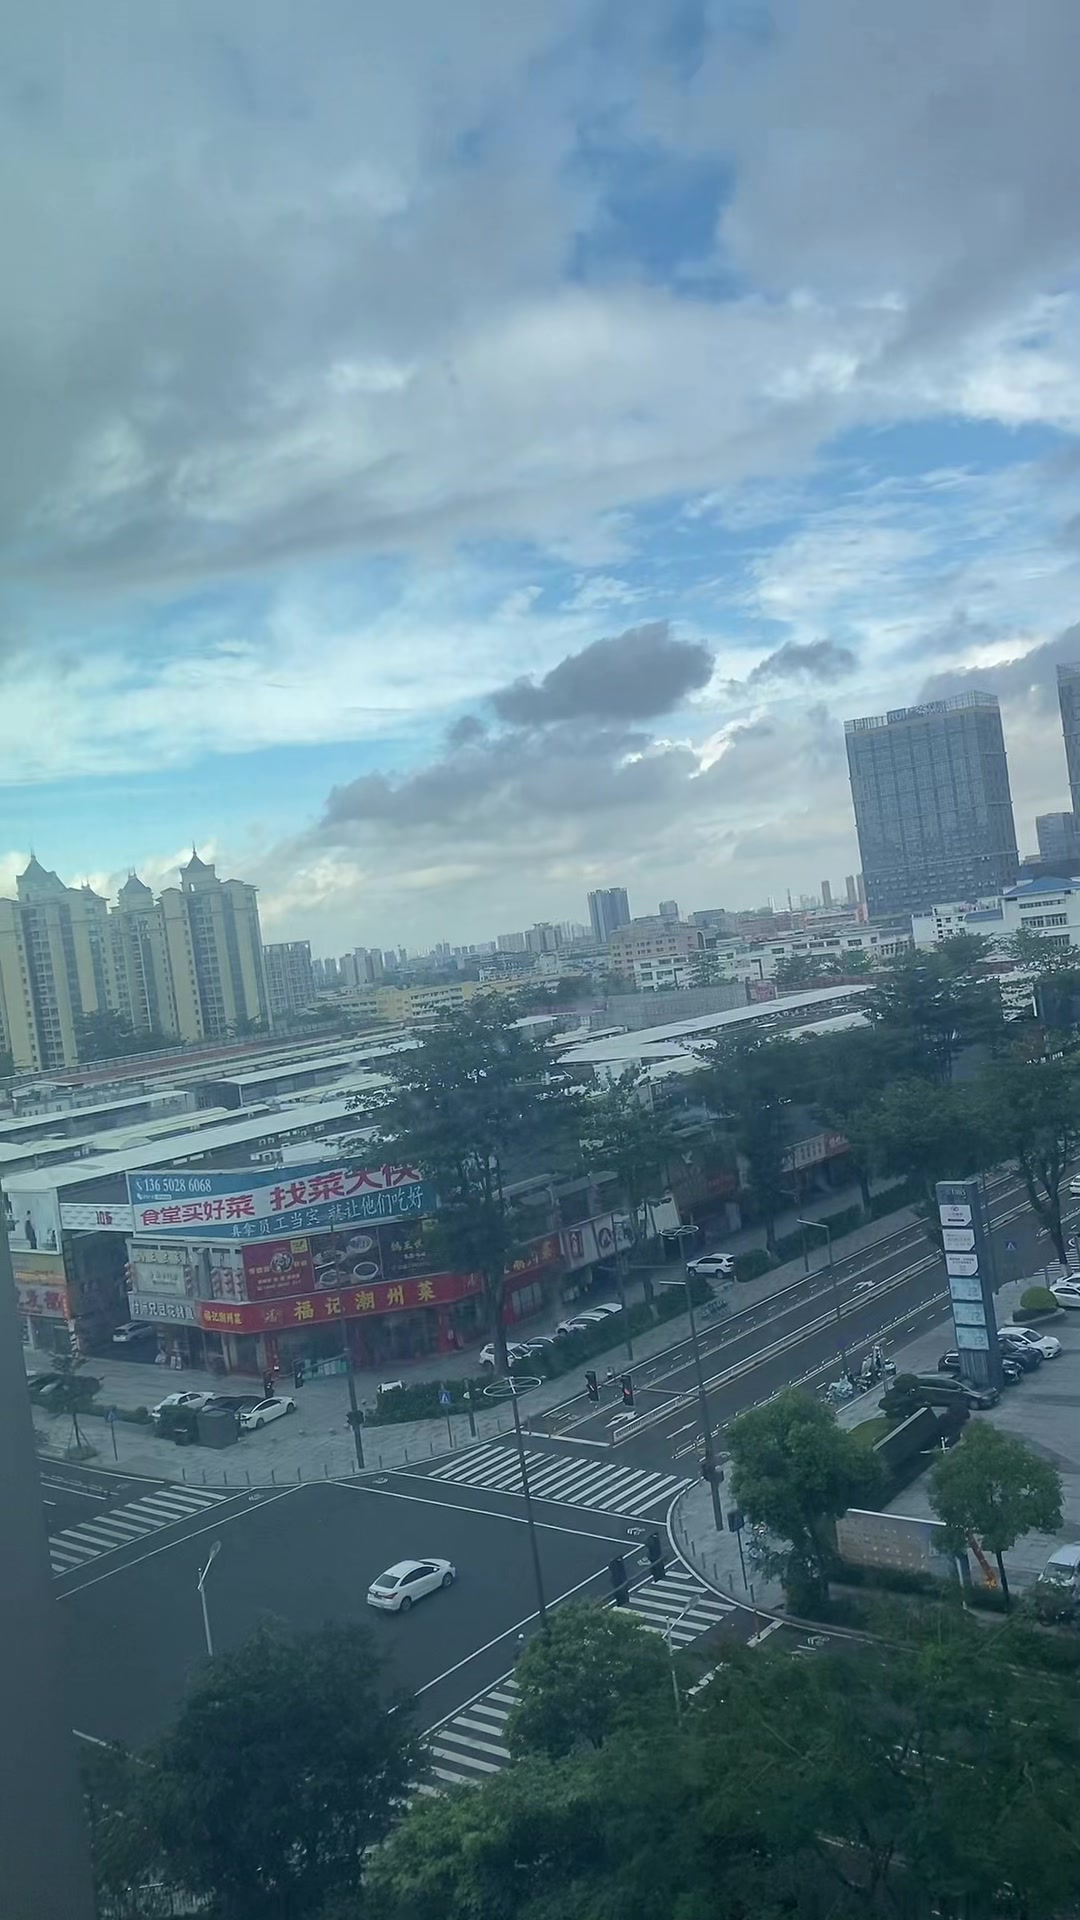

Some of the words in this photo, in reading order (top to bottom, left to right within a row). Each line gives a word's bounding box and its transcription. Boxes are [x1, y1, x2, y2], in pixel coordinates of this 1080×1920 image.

[144, 1178, 161, 1192] 136
[163, 1178, 187, 1192] 5028
[188, 1177, 212, 1192] 6068
[140, 1194, 256, 1226] 食堂买好菜
[327, 1185, 424, 1222] 就让他们吃好
[293, 1280, 437, 1321] 福记潮州菜
